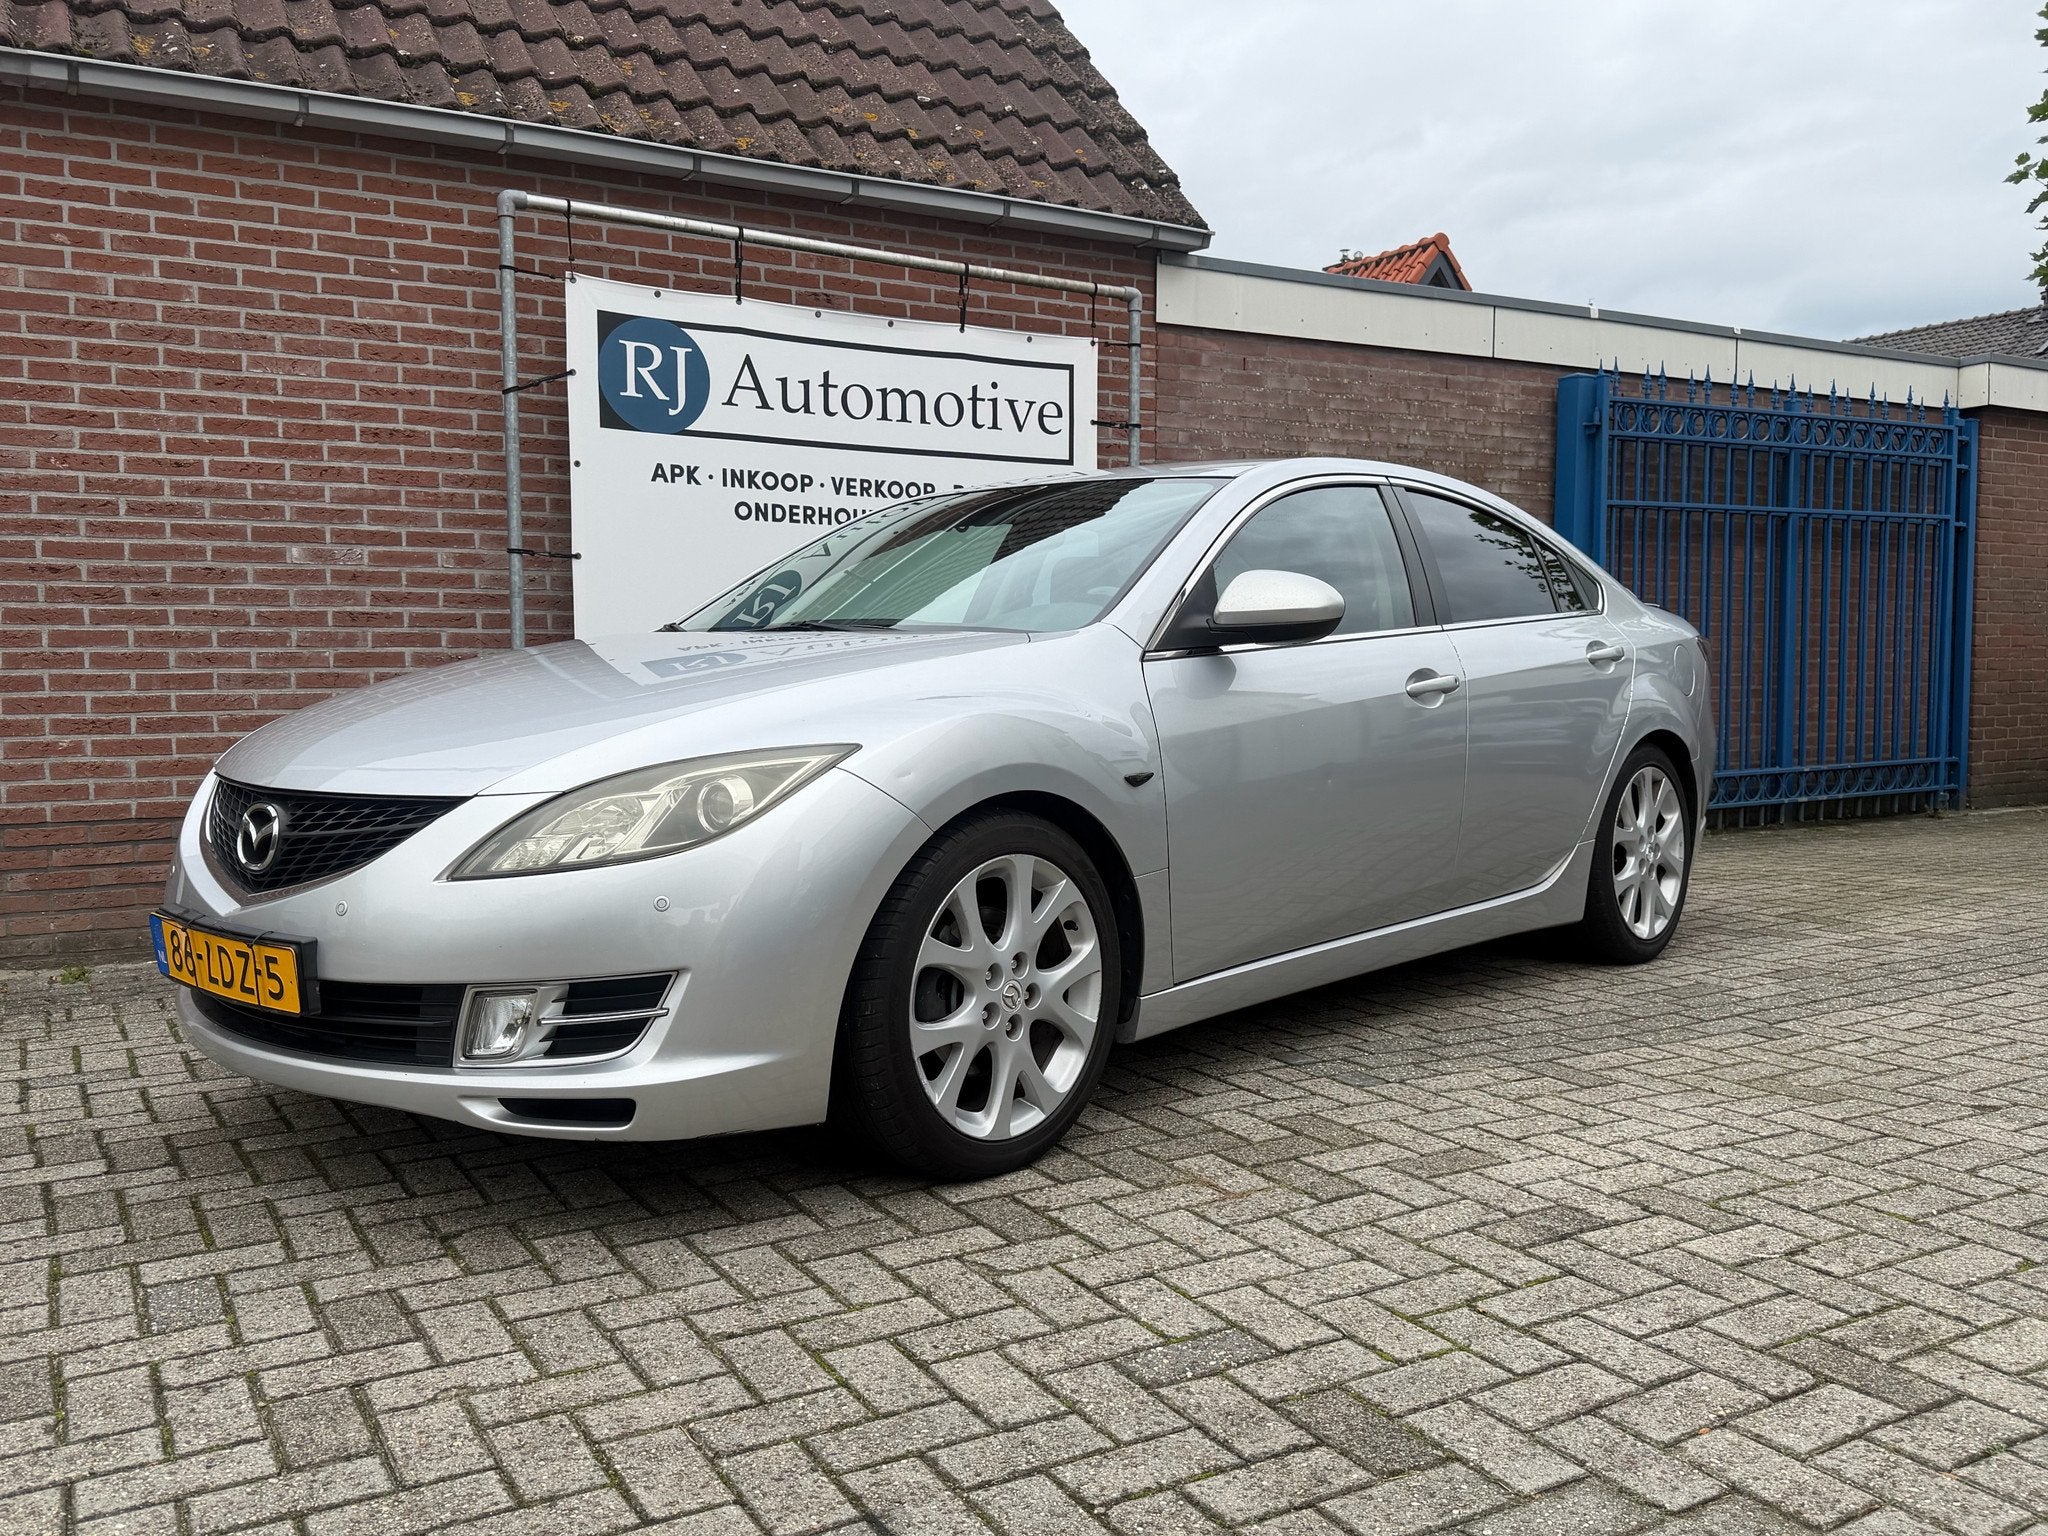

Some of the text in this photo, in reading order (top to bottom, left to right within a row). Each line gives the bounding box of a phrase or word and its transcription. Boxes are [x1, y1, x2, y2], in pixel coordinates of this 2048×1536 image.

[619, 339, 1064, 437] RJ Automotive
[651, 463, 936, 500] APK INKOOP VERKOOP
[734, 501, 873, 526] ONDERHO
